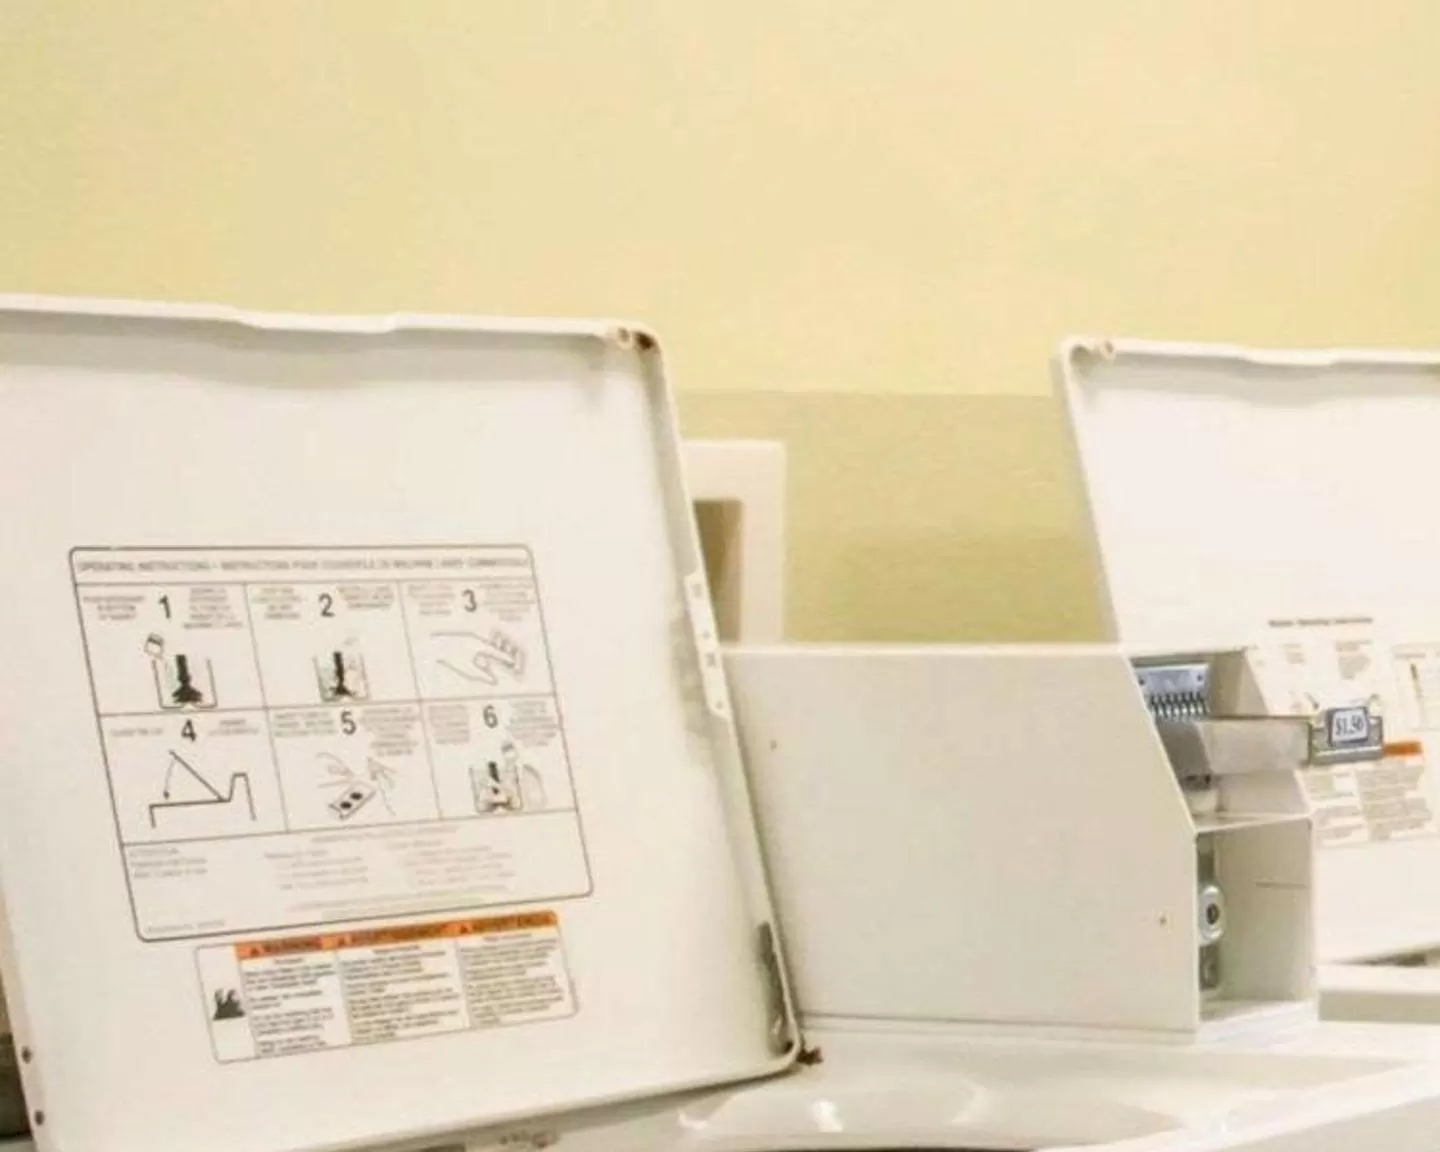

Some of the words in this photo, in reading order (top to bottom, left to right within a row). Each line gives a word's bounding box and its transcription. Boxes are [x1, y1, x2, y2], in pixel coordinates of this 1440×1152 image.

[159, 594, 171, 618] 1
[318, 593, 335, 617] 2
[462, 589, 477, 612] 3
[340, 710, 357, 735] 5
[483, 705, 498, 729] 6
[1335, 714, 1365, 736] $1.50
[180, 718, 197, 742] 4
